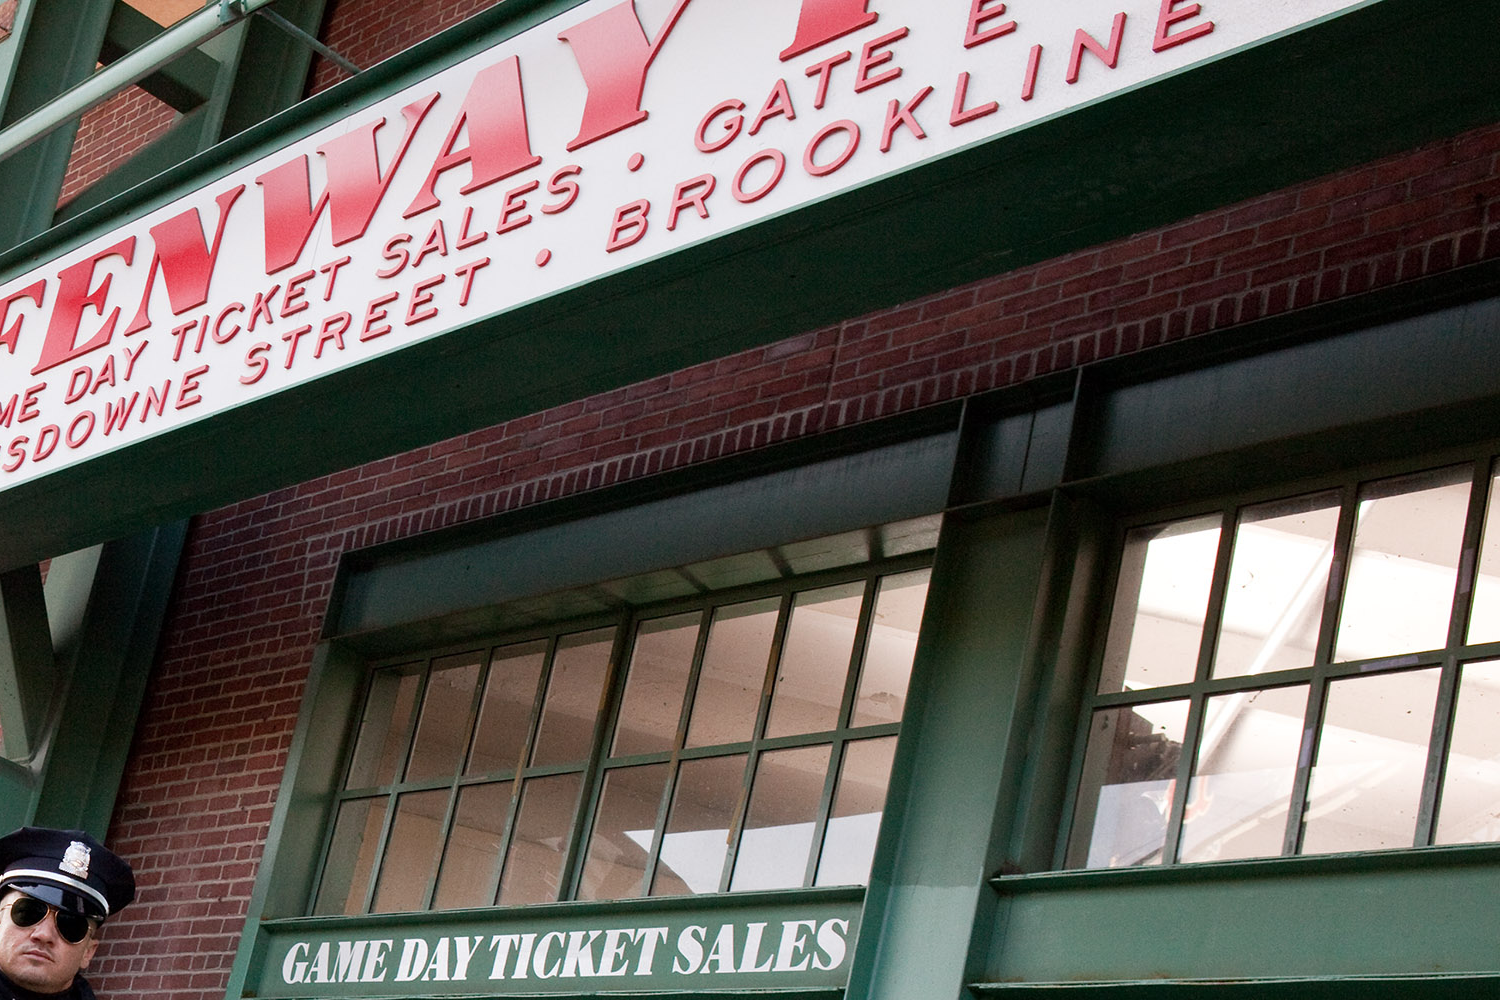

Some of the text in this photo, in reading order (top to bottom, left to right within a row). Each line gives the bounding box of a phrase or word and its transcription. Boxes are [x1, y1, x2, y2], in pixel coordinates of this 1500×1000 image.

[64, 341, 147, 405] DAY
[171, 256, 351, 362] TICKET
[376, 164, 583, 279] SALES
[694, 26, 910, 154] GATE
[963, 0, 1018, 49] E
[239, 256, 491, 386] STREET
[605, 0, 1216, 253] BROOKLINE
[282, 917, 851, 984] GAME DAY TICKET SALES
